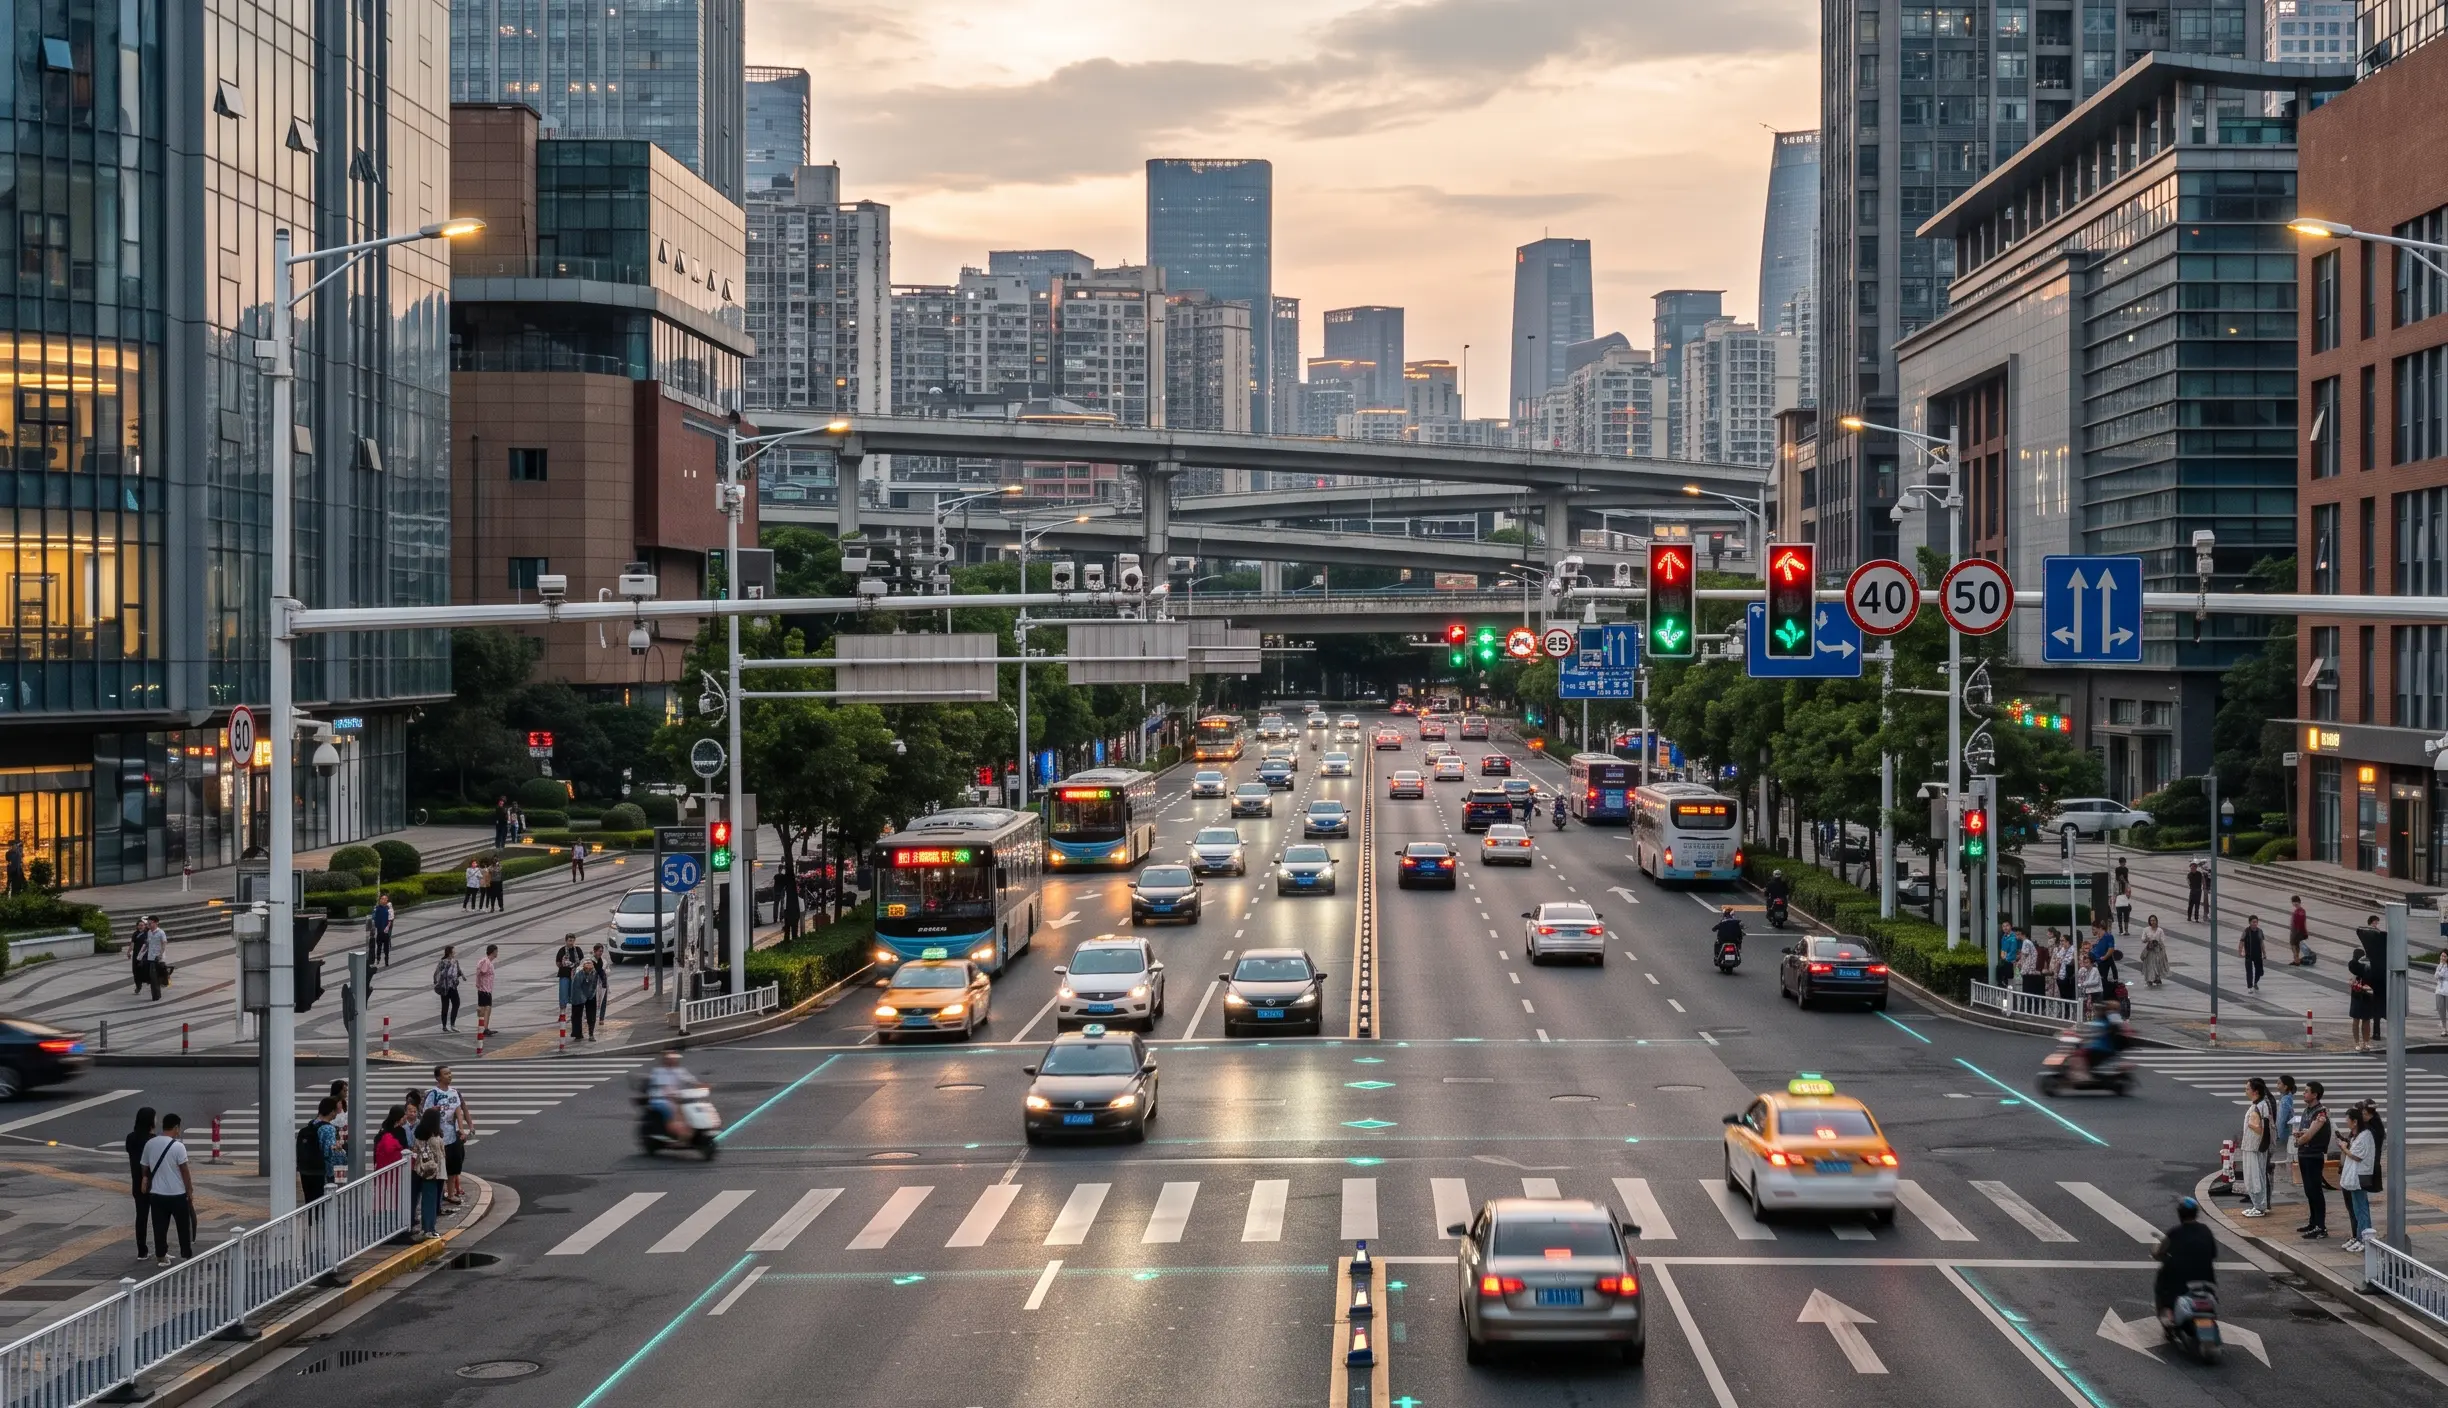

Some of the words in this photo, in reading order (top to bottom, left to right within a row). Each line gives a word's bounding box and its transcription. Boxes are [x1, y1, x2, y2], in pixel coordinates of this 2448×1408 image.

[1859, 581, 1906, 614] 40
[1954, 581, 2000, 614] 50
[234, 719, 250, 752] 80
[664, 862, 697, 887] 50
